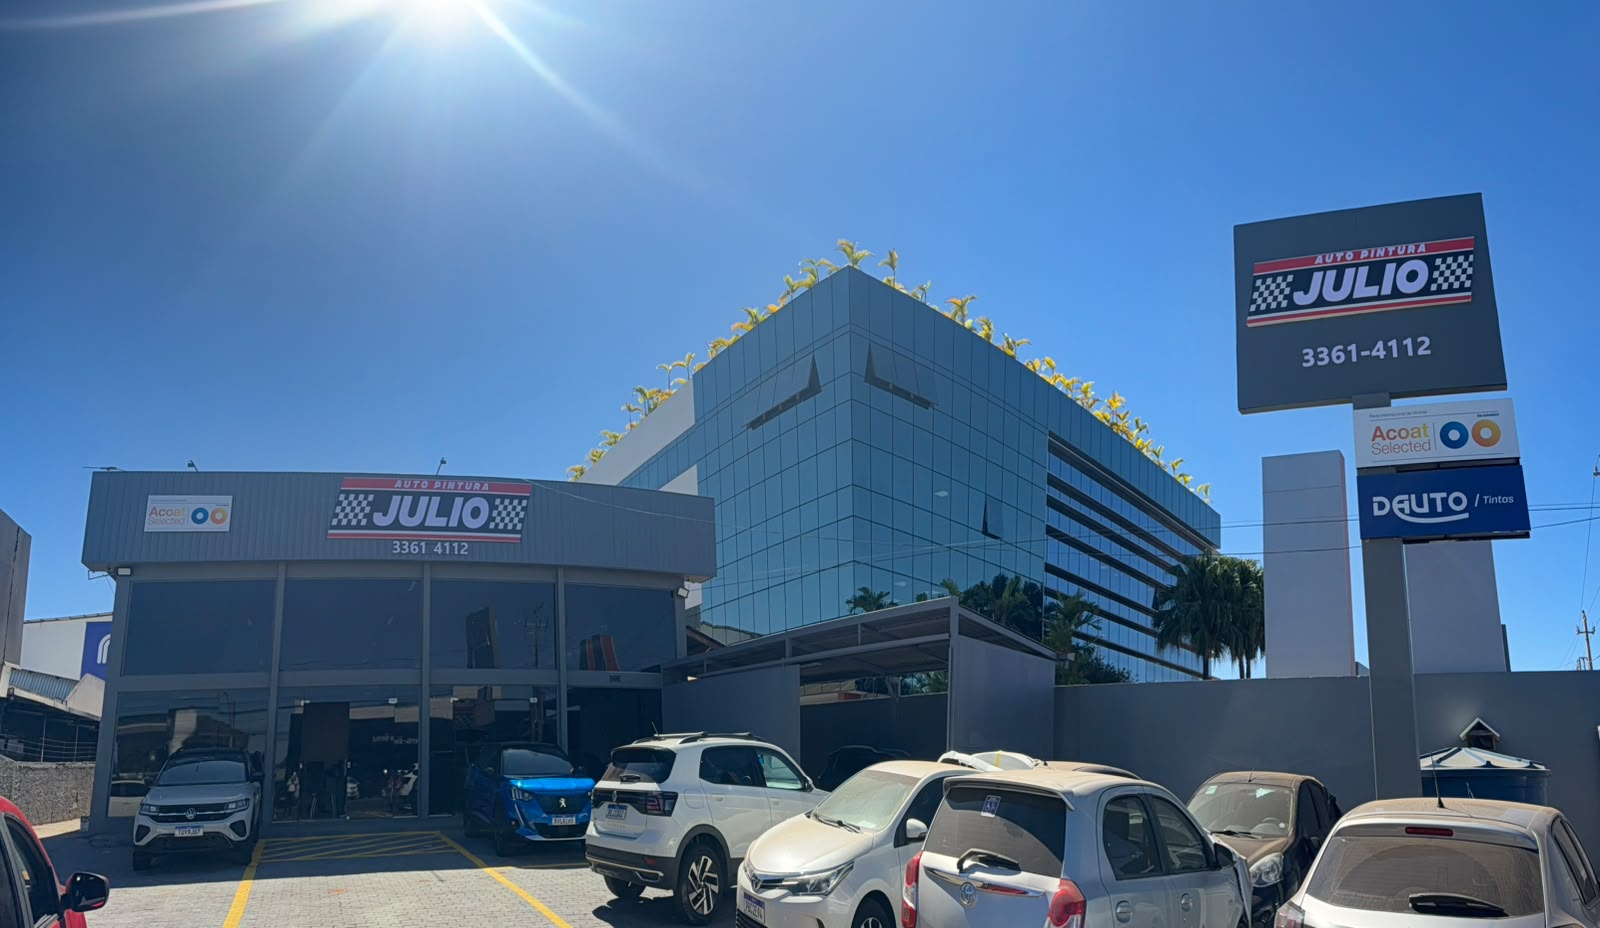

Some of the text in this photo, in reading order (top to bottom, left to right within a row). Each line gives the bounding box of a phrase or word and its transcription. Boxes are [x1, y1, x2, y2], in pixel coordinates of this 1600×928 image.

[1314, 243, 1427, 265] AUTO PINTURA
[1293, 259, 1429, 306] JULIO
[1302, 336, 1431, 367] 3361-4112
[1371, 423, 1430, 442] Acoat
[1371, 439, 1431, 455] Selected
[394, 480, 489, 491] AUTO PINTURA
[1483, 495, 1514, 505] Tintas
[149, 506, 185, 517] Acoat
[373, 495, 489, 529] JULIO
[392, 541, 469, 555] 3361 4112
